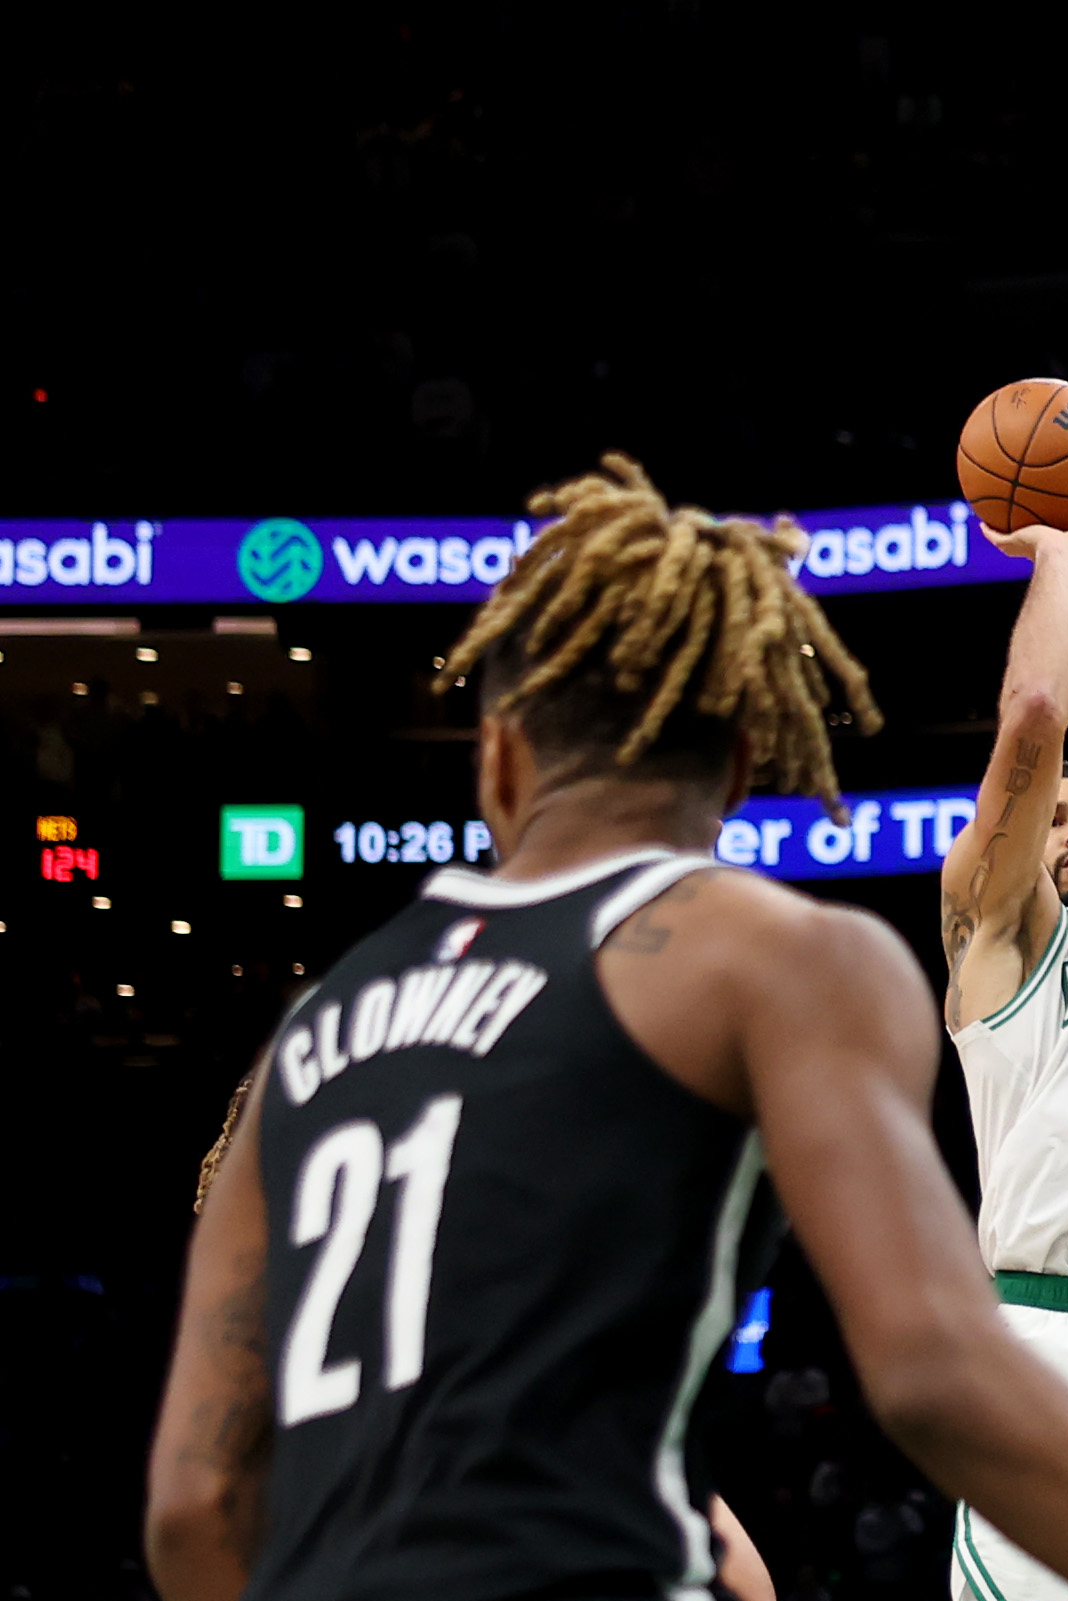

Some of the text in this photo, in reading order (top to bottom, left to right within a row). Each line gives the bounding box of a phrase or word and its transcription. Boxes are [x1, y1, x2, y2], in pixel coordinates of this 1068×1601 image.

[787, 502, 969, 580] asabi
[41, 845, 99, 882] 124
[229, 817, 297, 867] TD
[333, 820, 454, 864] 10:26
[806, 799, 882, 866] of
[889, 797, 977, 860] TD
[279, 962, 549, 1106] CLOWNEY
[281, 1094, 464, 1429] 21
